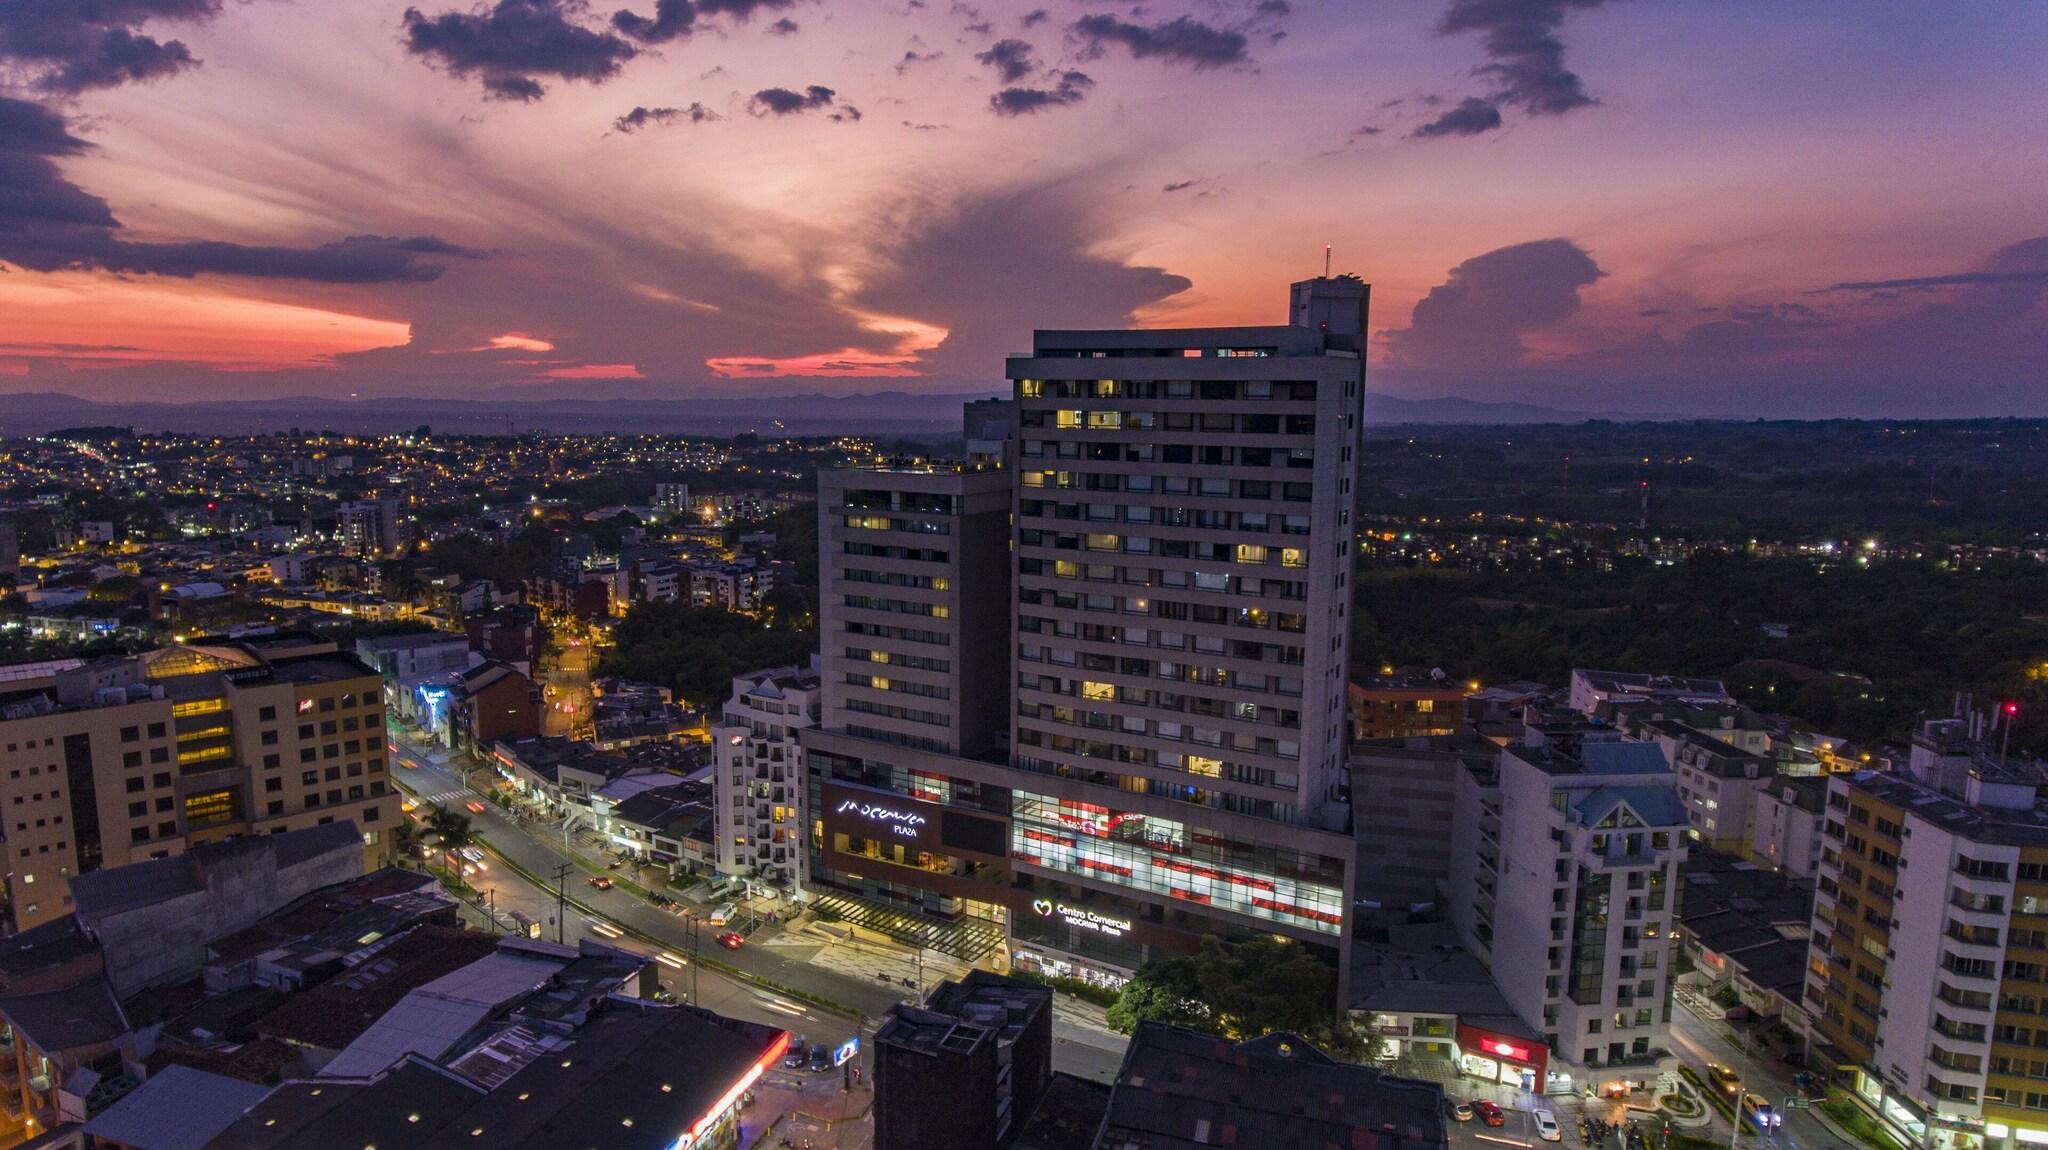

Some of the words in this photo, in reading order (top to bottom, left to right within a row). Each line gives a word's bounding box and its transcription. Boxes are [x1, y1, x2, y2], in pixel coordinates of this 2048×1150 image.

[894, 825, 917, 837] PLAZA
[1057, 904, 1086, 920] Centro
[1087, 911, 1131, 931] Comercial
[1065, 916, 1099, 931] MOCAWA
